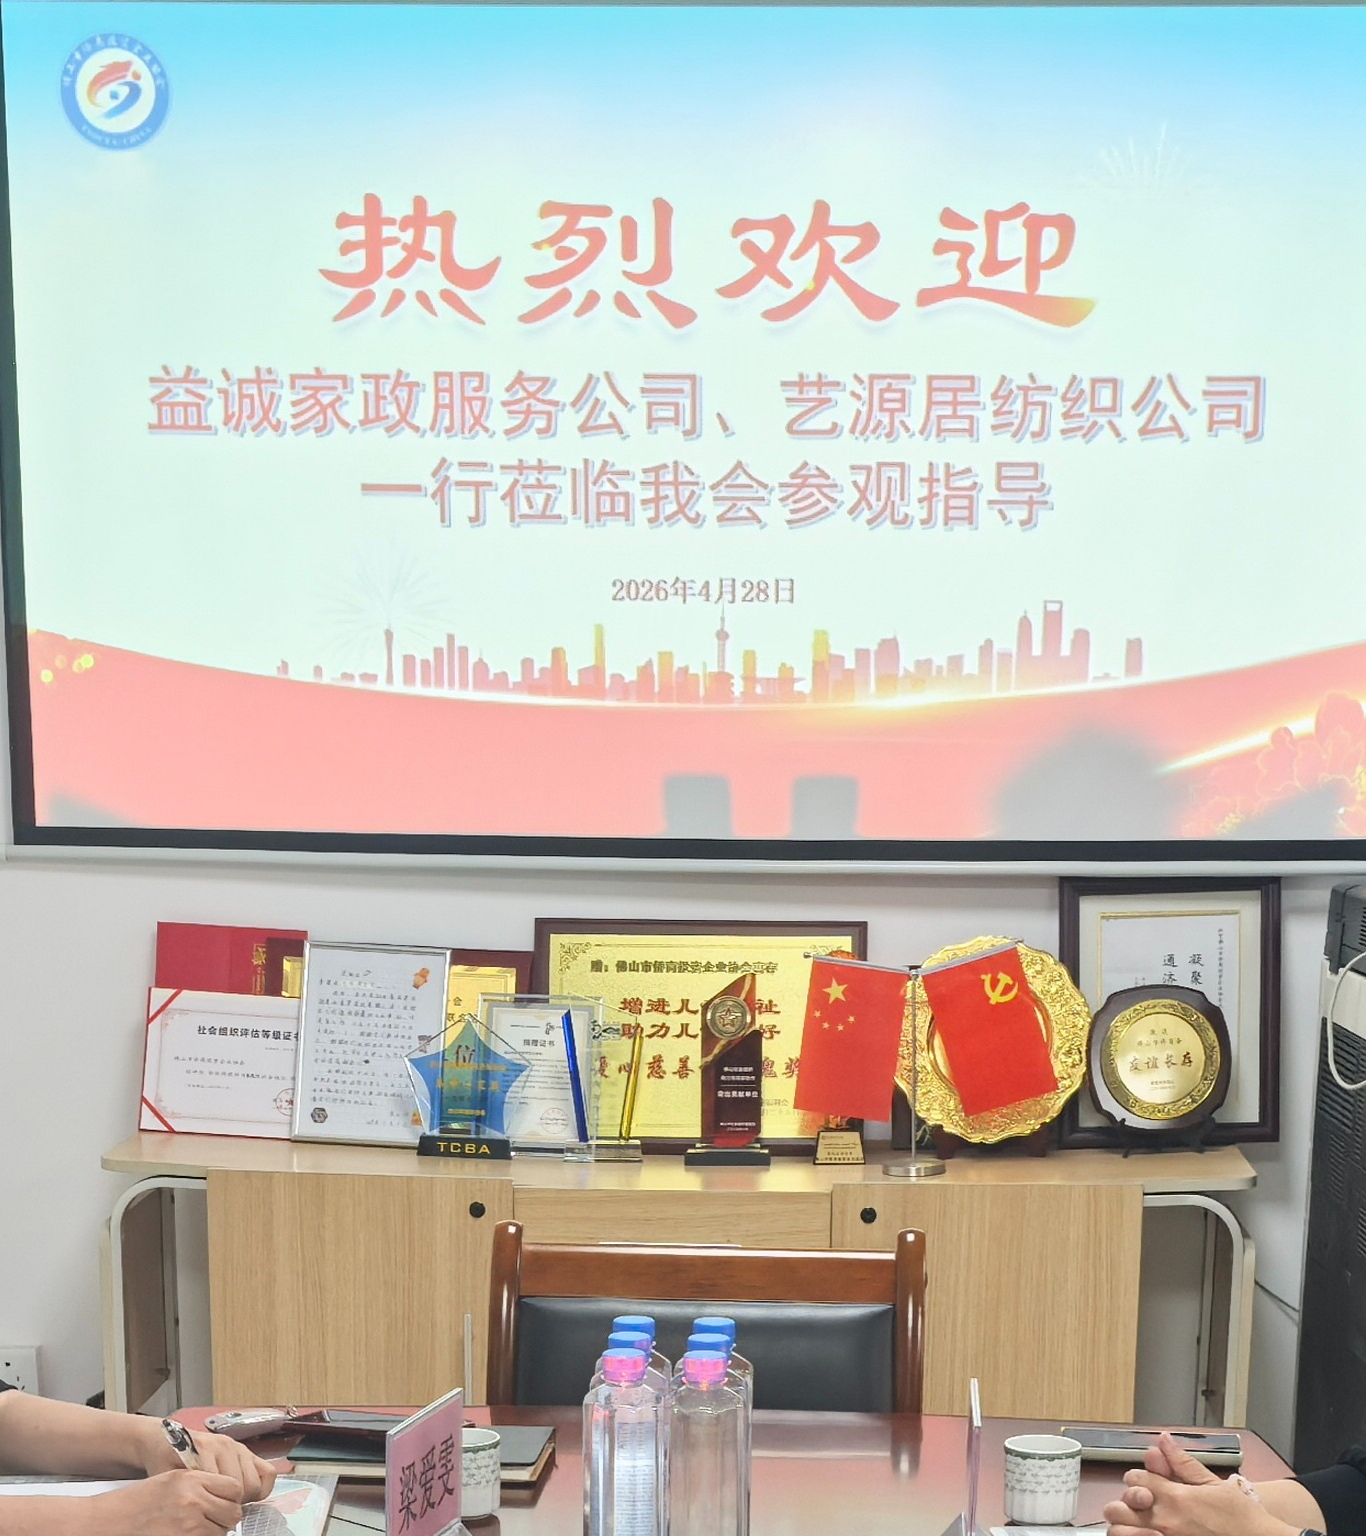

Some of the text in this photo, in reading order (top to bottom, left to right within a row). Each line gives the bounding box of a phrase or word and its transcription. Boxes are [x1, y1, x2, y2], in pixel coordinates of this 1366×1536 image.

[318, 192, 1099, 330] 热烈欢迎
[147, 364, 1266, 443] 益诚家政服务公司、艺源居纺织公司
[360, 457, 1054, 530] 一行莅临我会参观指导
[609, 576, 796, 605] 2026年4月28日
[1129, 1052, 1194, 1072] 友谊长存
